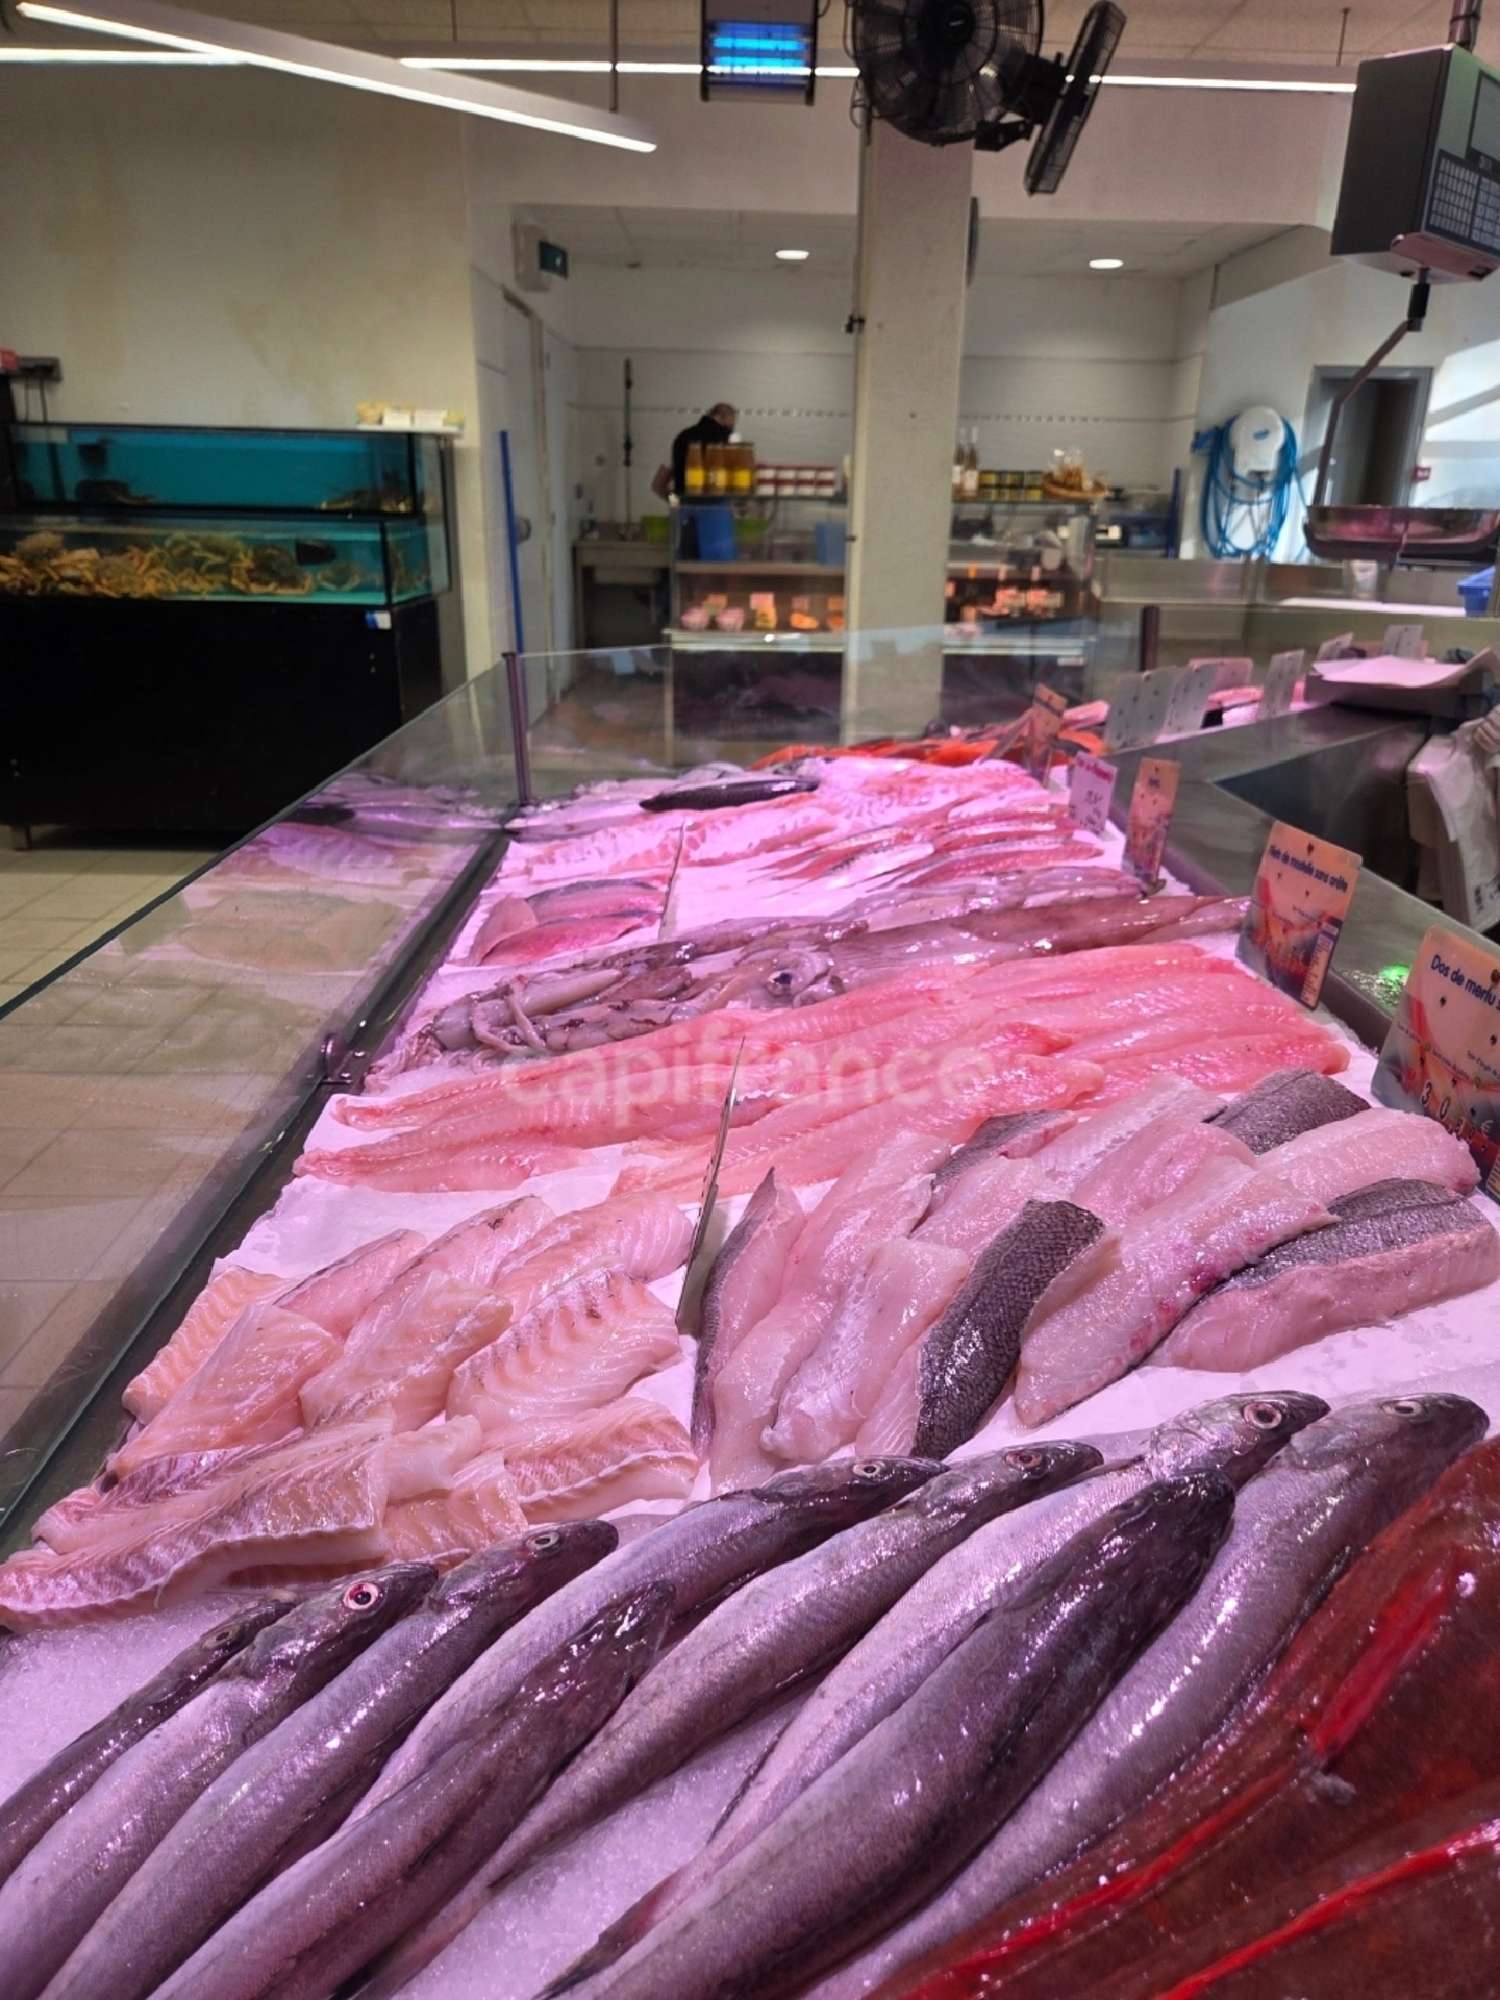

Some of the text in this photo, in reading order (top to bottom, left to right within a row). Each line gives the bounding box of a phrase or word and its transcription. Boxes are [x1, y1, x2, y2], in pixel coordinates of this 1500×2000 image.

[1430, 954, 1450, 977] Dos
[1450, 968, 1465, 987] de
[1465, 978, 1497, 1006] merlu
